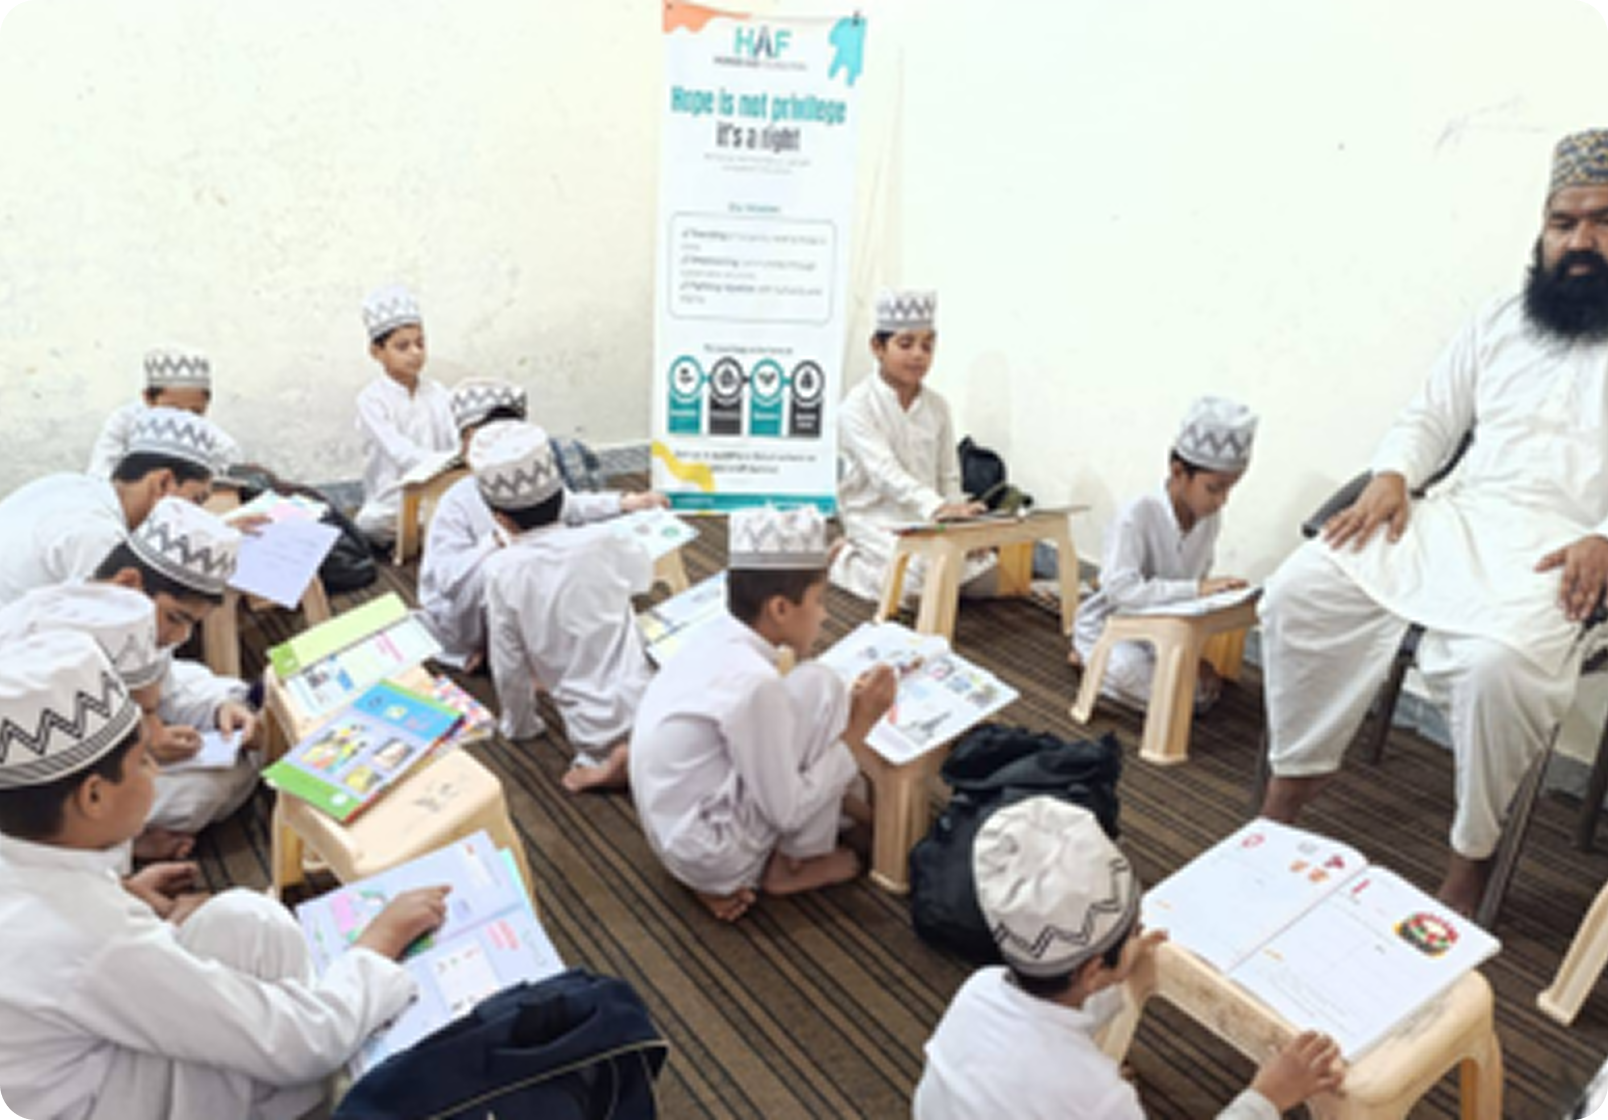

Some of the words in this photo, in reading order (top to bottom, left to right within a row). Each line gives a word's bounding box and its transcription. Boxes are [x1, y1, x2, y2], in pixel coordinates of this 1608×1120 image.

[734, 26, 792, 58] HAF
[671, 86, 713, 117] Hope
[719, 87, 734, 116] is
[738, 93, 767, 119] not
[772, 93, 847, 125] privilege
[746, 127, 757, 149] a
[760, 123, 801, 153] right
